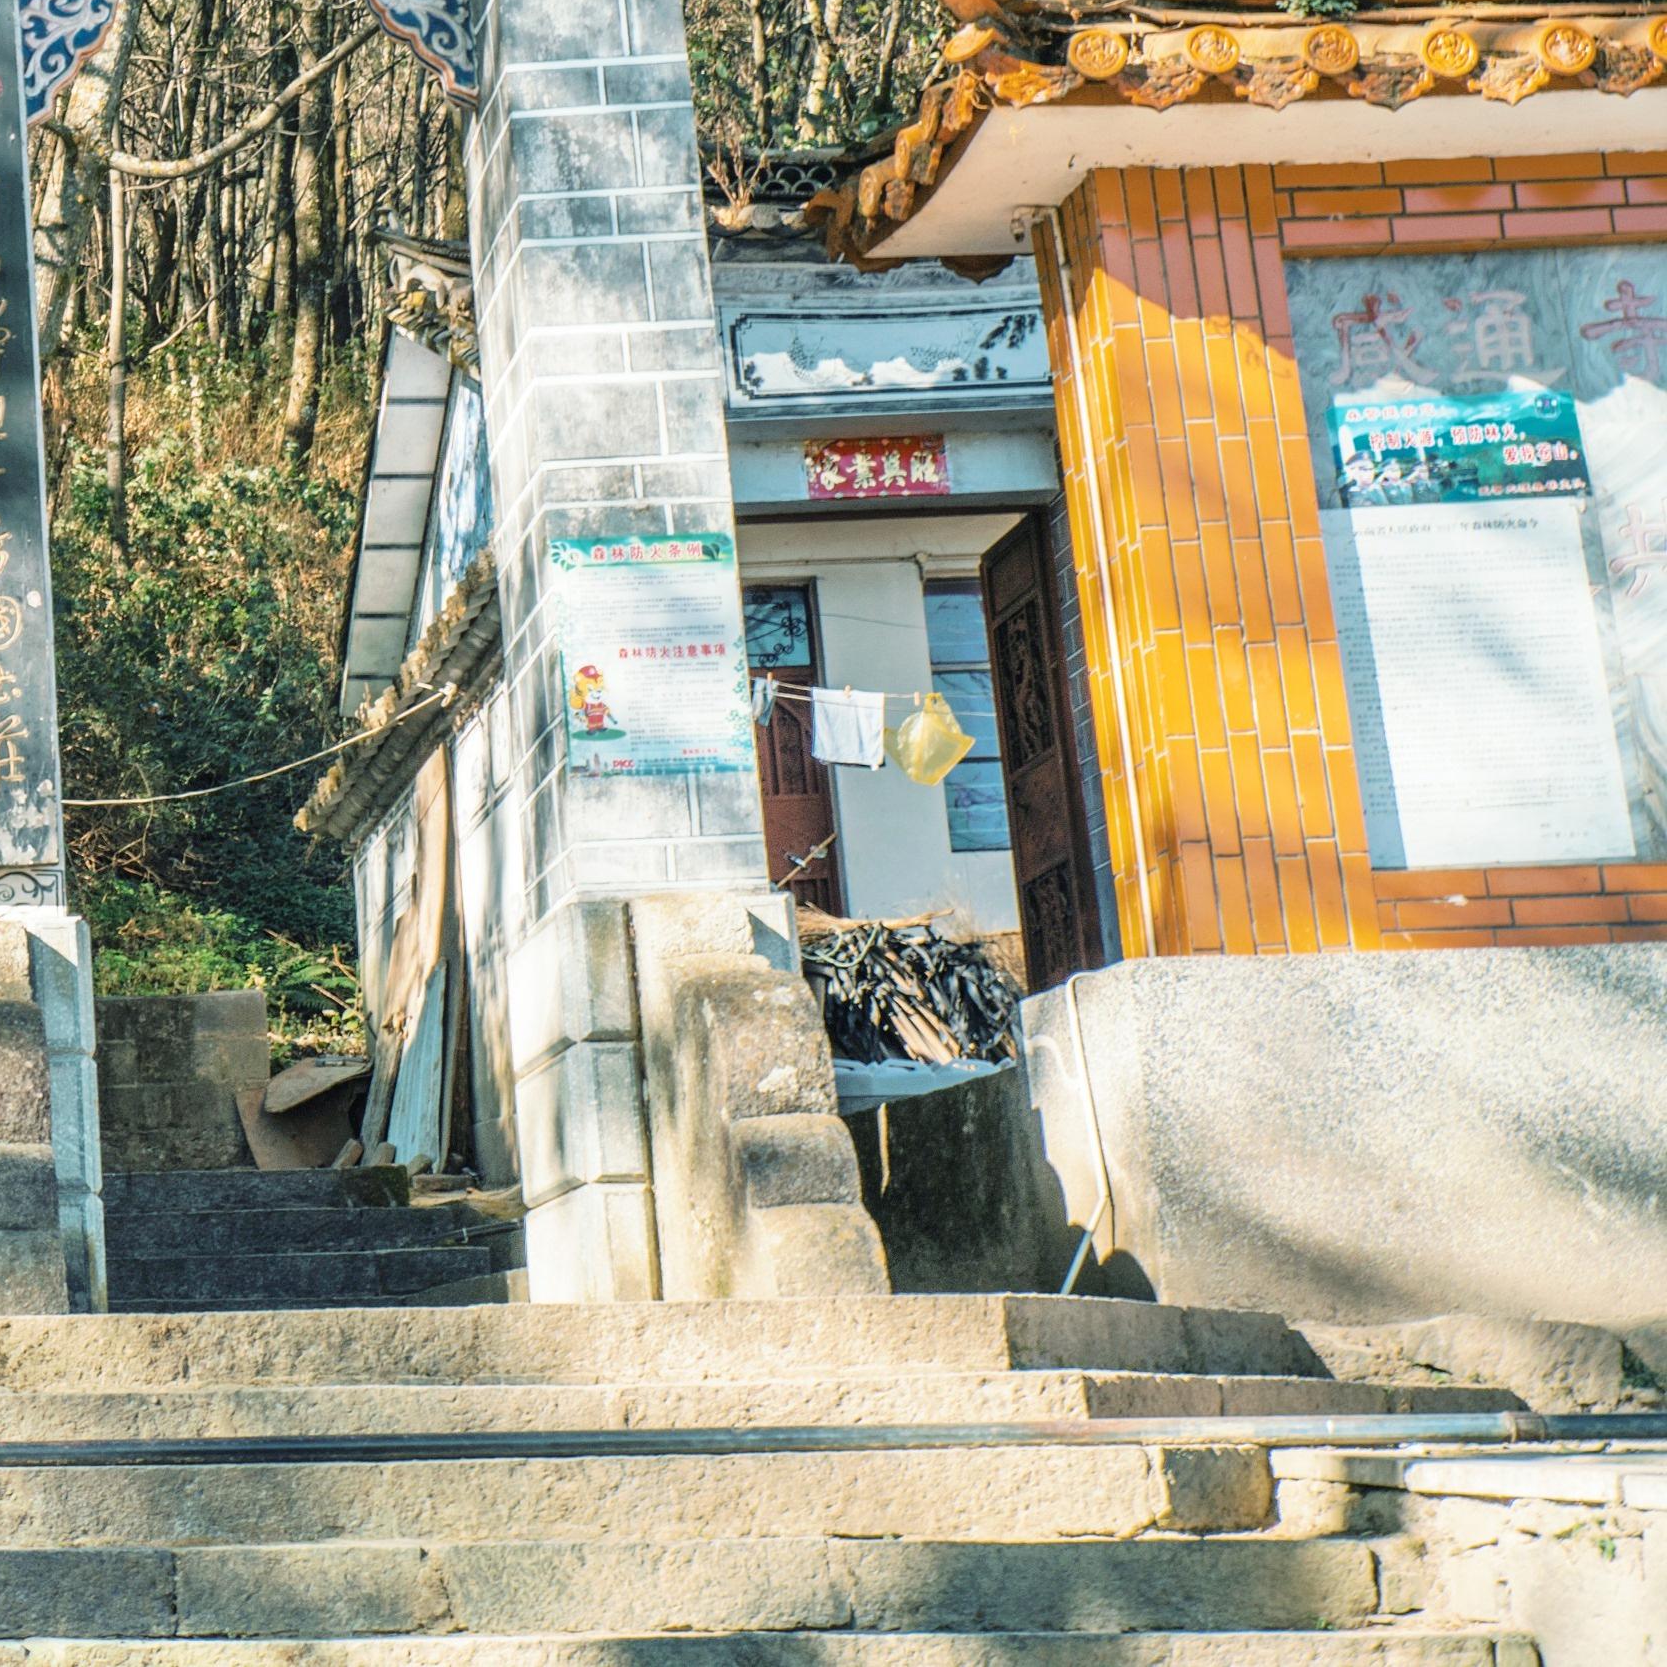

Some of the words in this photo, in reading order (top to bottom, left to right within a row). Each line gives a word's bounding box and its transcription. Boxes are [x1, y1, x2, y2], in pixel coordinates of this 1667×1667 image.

[591, 543, 704, 562] 森林防火条例
